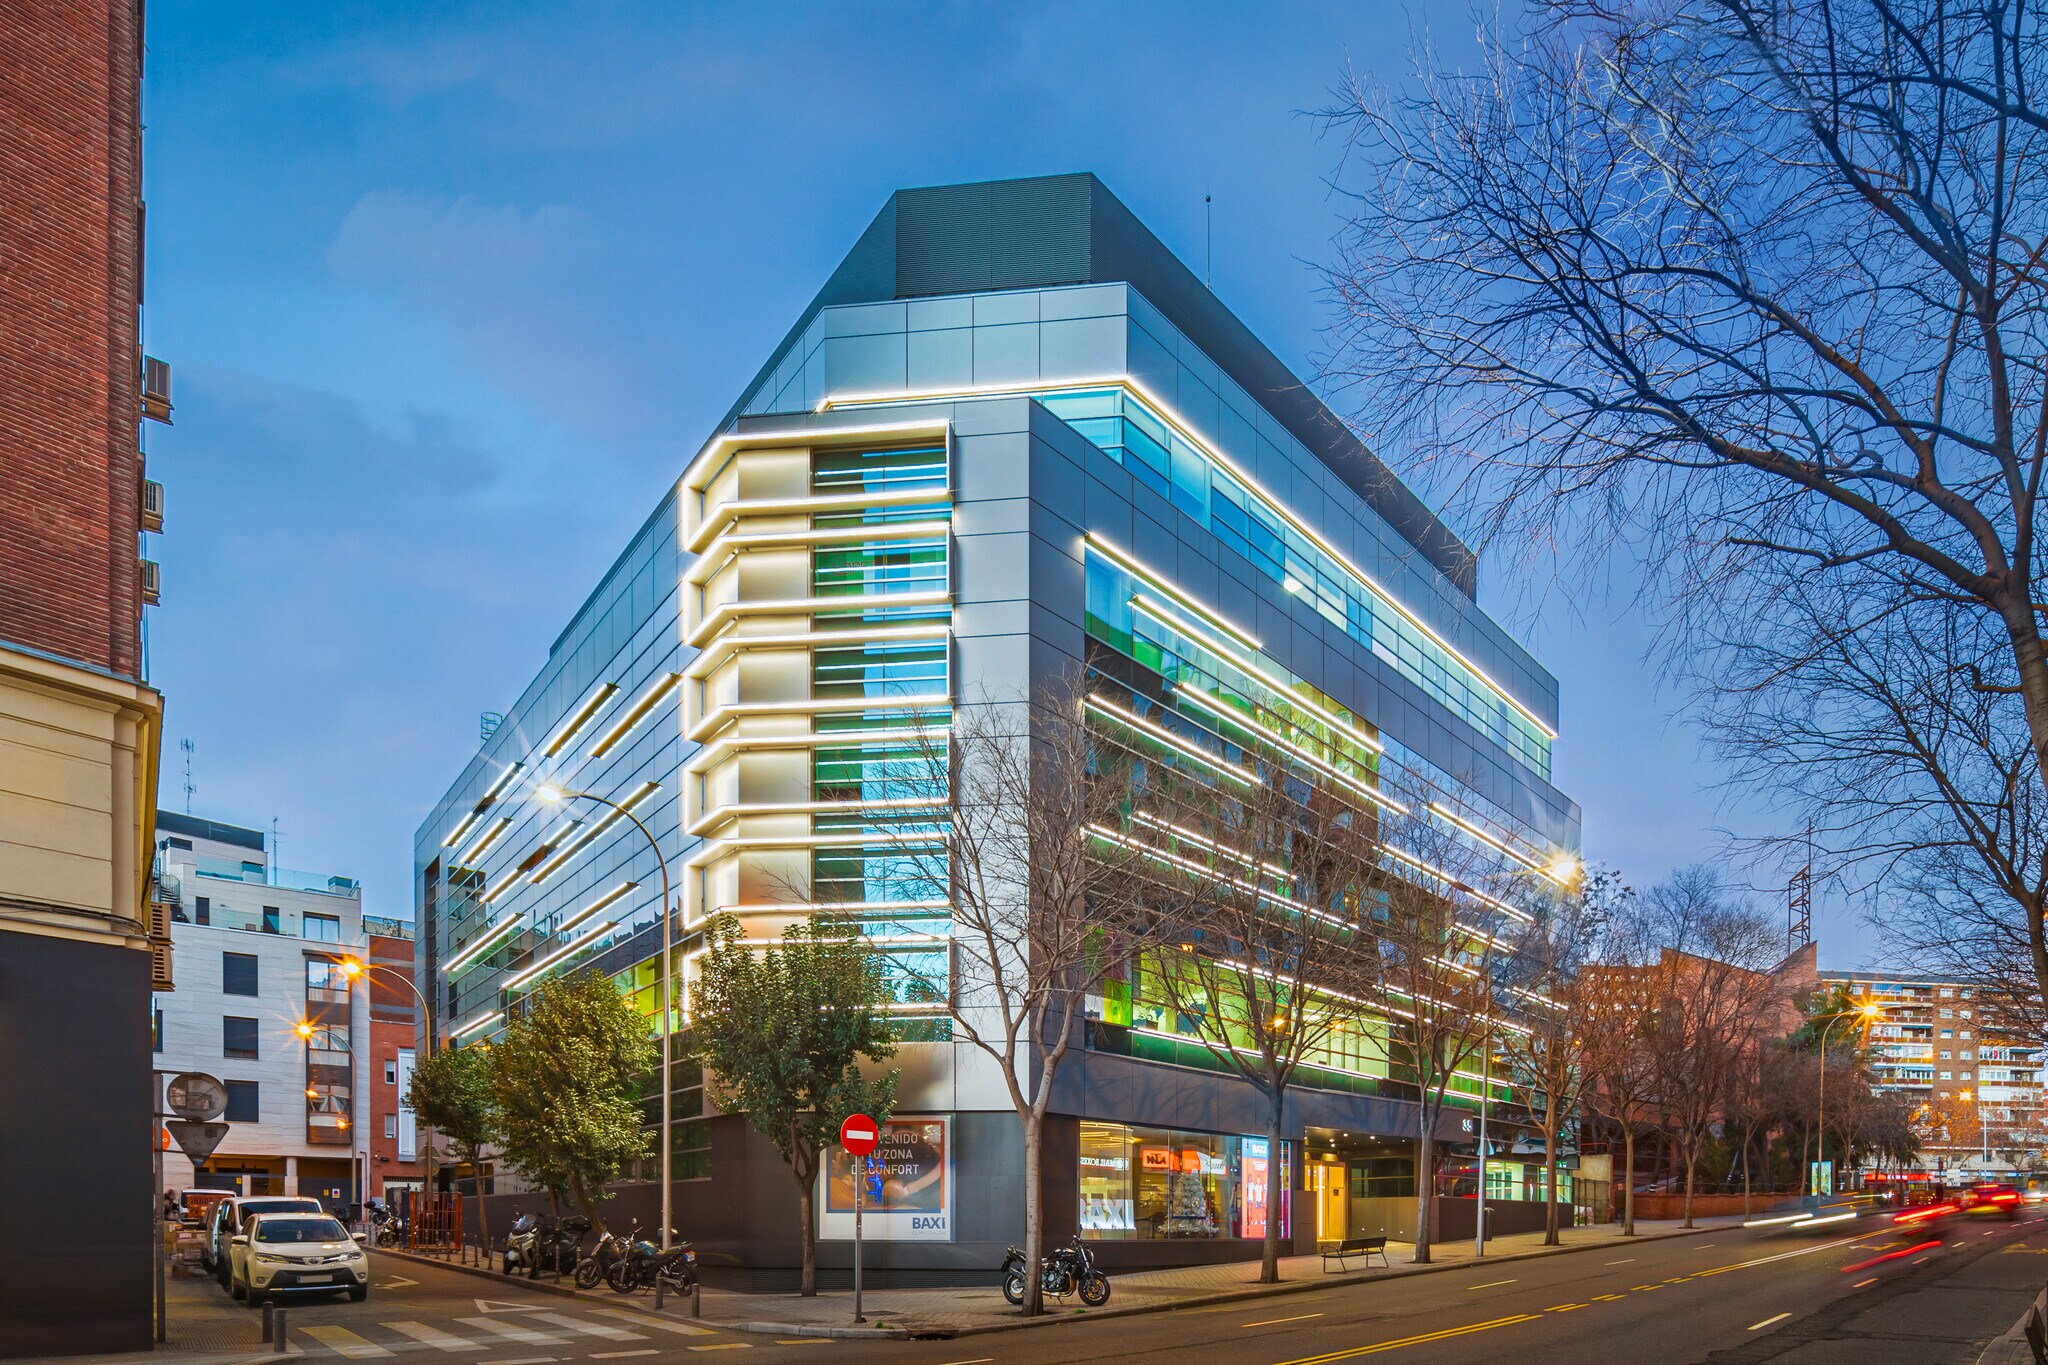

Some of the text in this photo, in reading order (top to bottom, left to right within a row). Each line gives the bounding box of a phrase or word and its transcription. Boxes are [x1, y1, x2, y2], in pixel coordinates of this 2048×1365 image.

[884, 1149, 913, 1160] ZONA
[868, 1164, 919, 1175] CONFORT
[912, 1217, 946, 1230] BAXI
